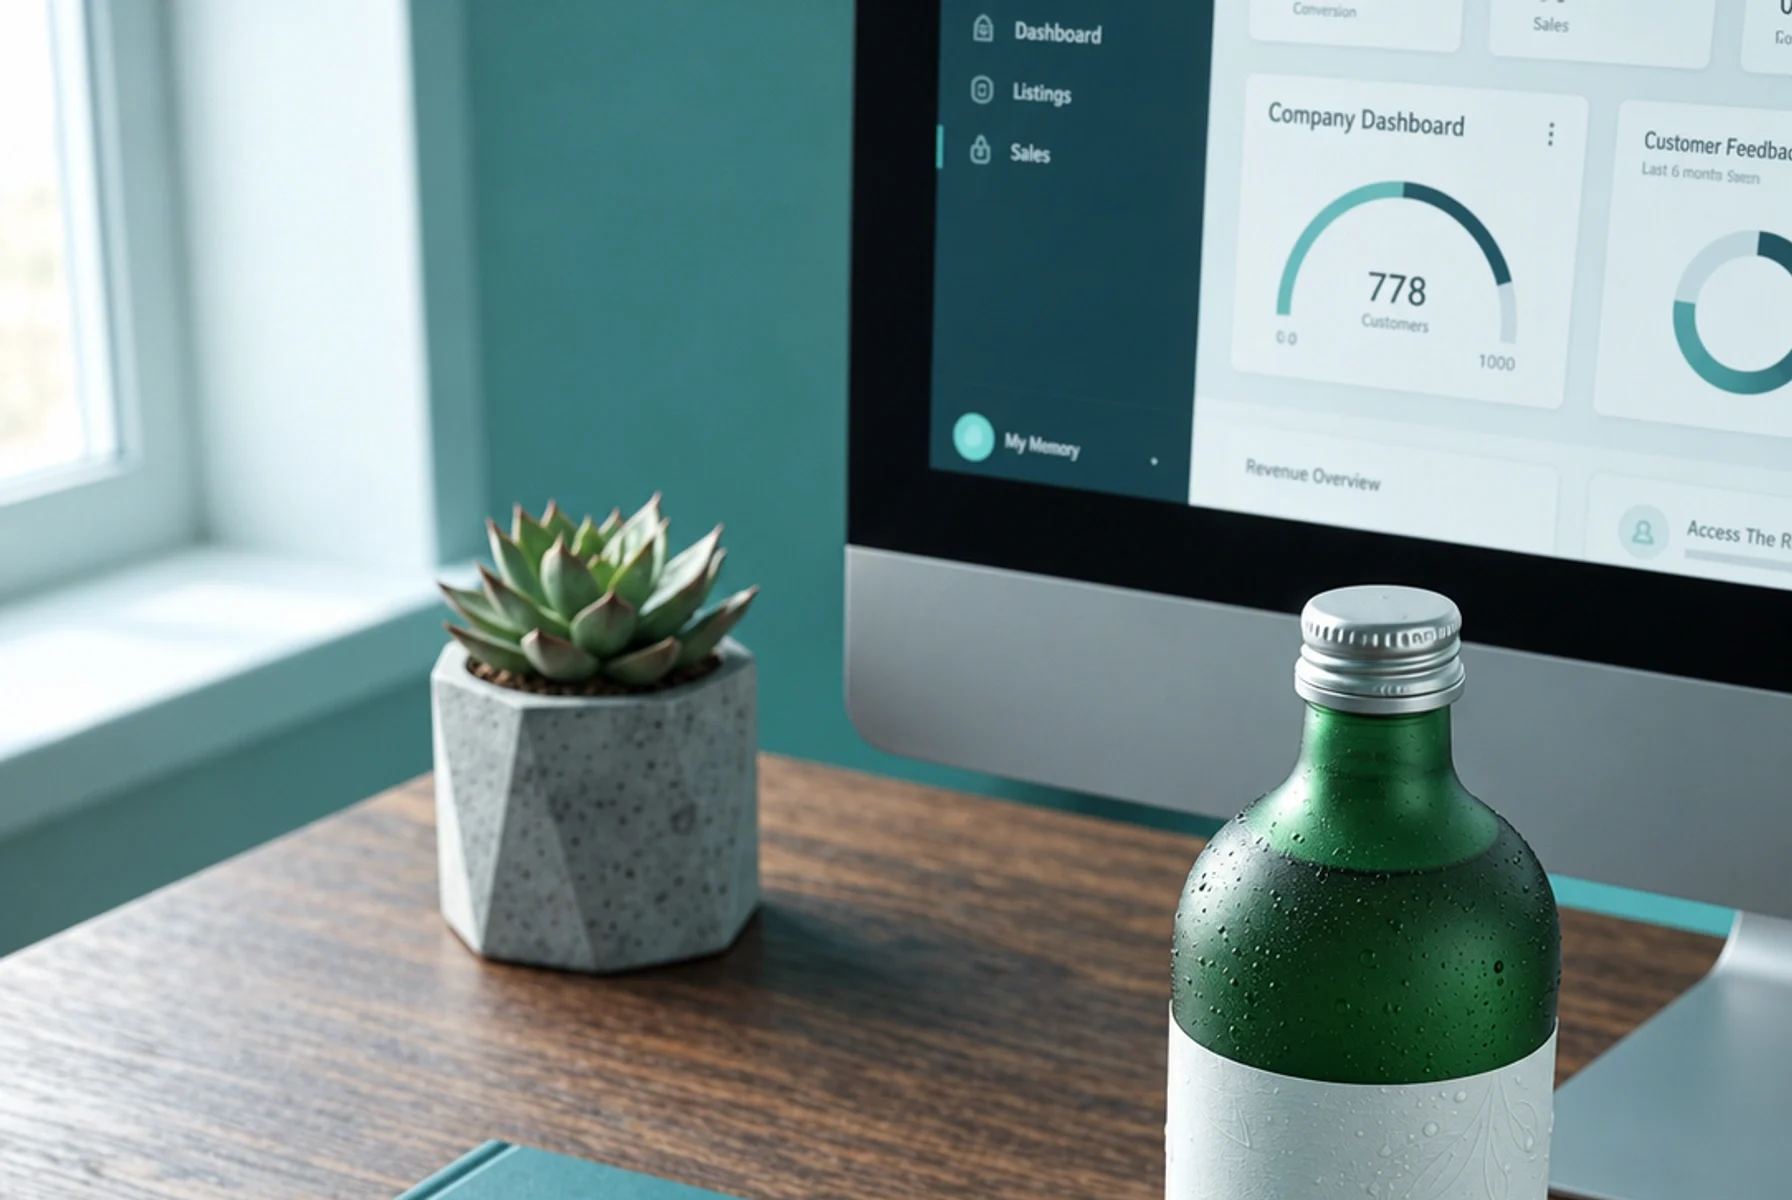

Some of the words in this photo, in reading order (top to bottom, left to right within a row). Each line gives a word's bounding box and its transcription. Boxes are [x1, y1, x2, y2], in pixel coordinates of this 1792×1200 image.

[1292, 1, 1357, 19] Conversion
[1015, 20, 1102, 45] Dashboard
[1533, 16, 1569, 33] Sales
[1012, 81, 1072, 107] Listings
[1268, 101, 1356, 135] Company
[1361, 108, 1465, 137] Dashboard
[1010, 143, 1051, 163] Sales
[1644, 130, 1722, 155] Customer
[1641, 161, 1668, 177] Last
[1671, 164, 1680, 178] 6
[1368, 271, 1427, 307] 778
[1361, 313, 1430, 334] Customers
[1479, 353, 1516, 372] 1000
[1004, 431, 1027, 455] My
[1246, 457, 1309, 482] Revenue
[1312, 467, 1382, 492] Overview
[1687, 519, 1741, 543] Access
[1745, 527, 1776, 548] The
